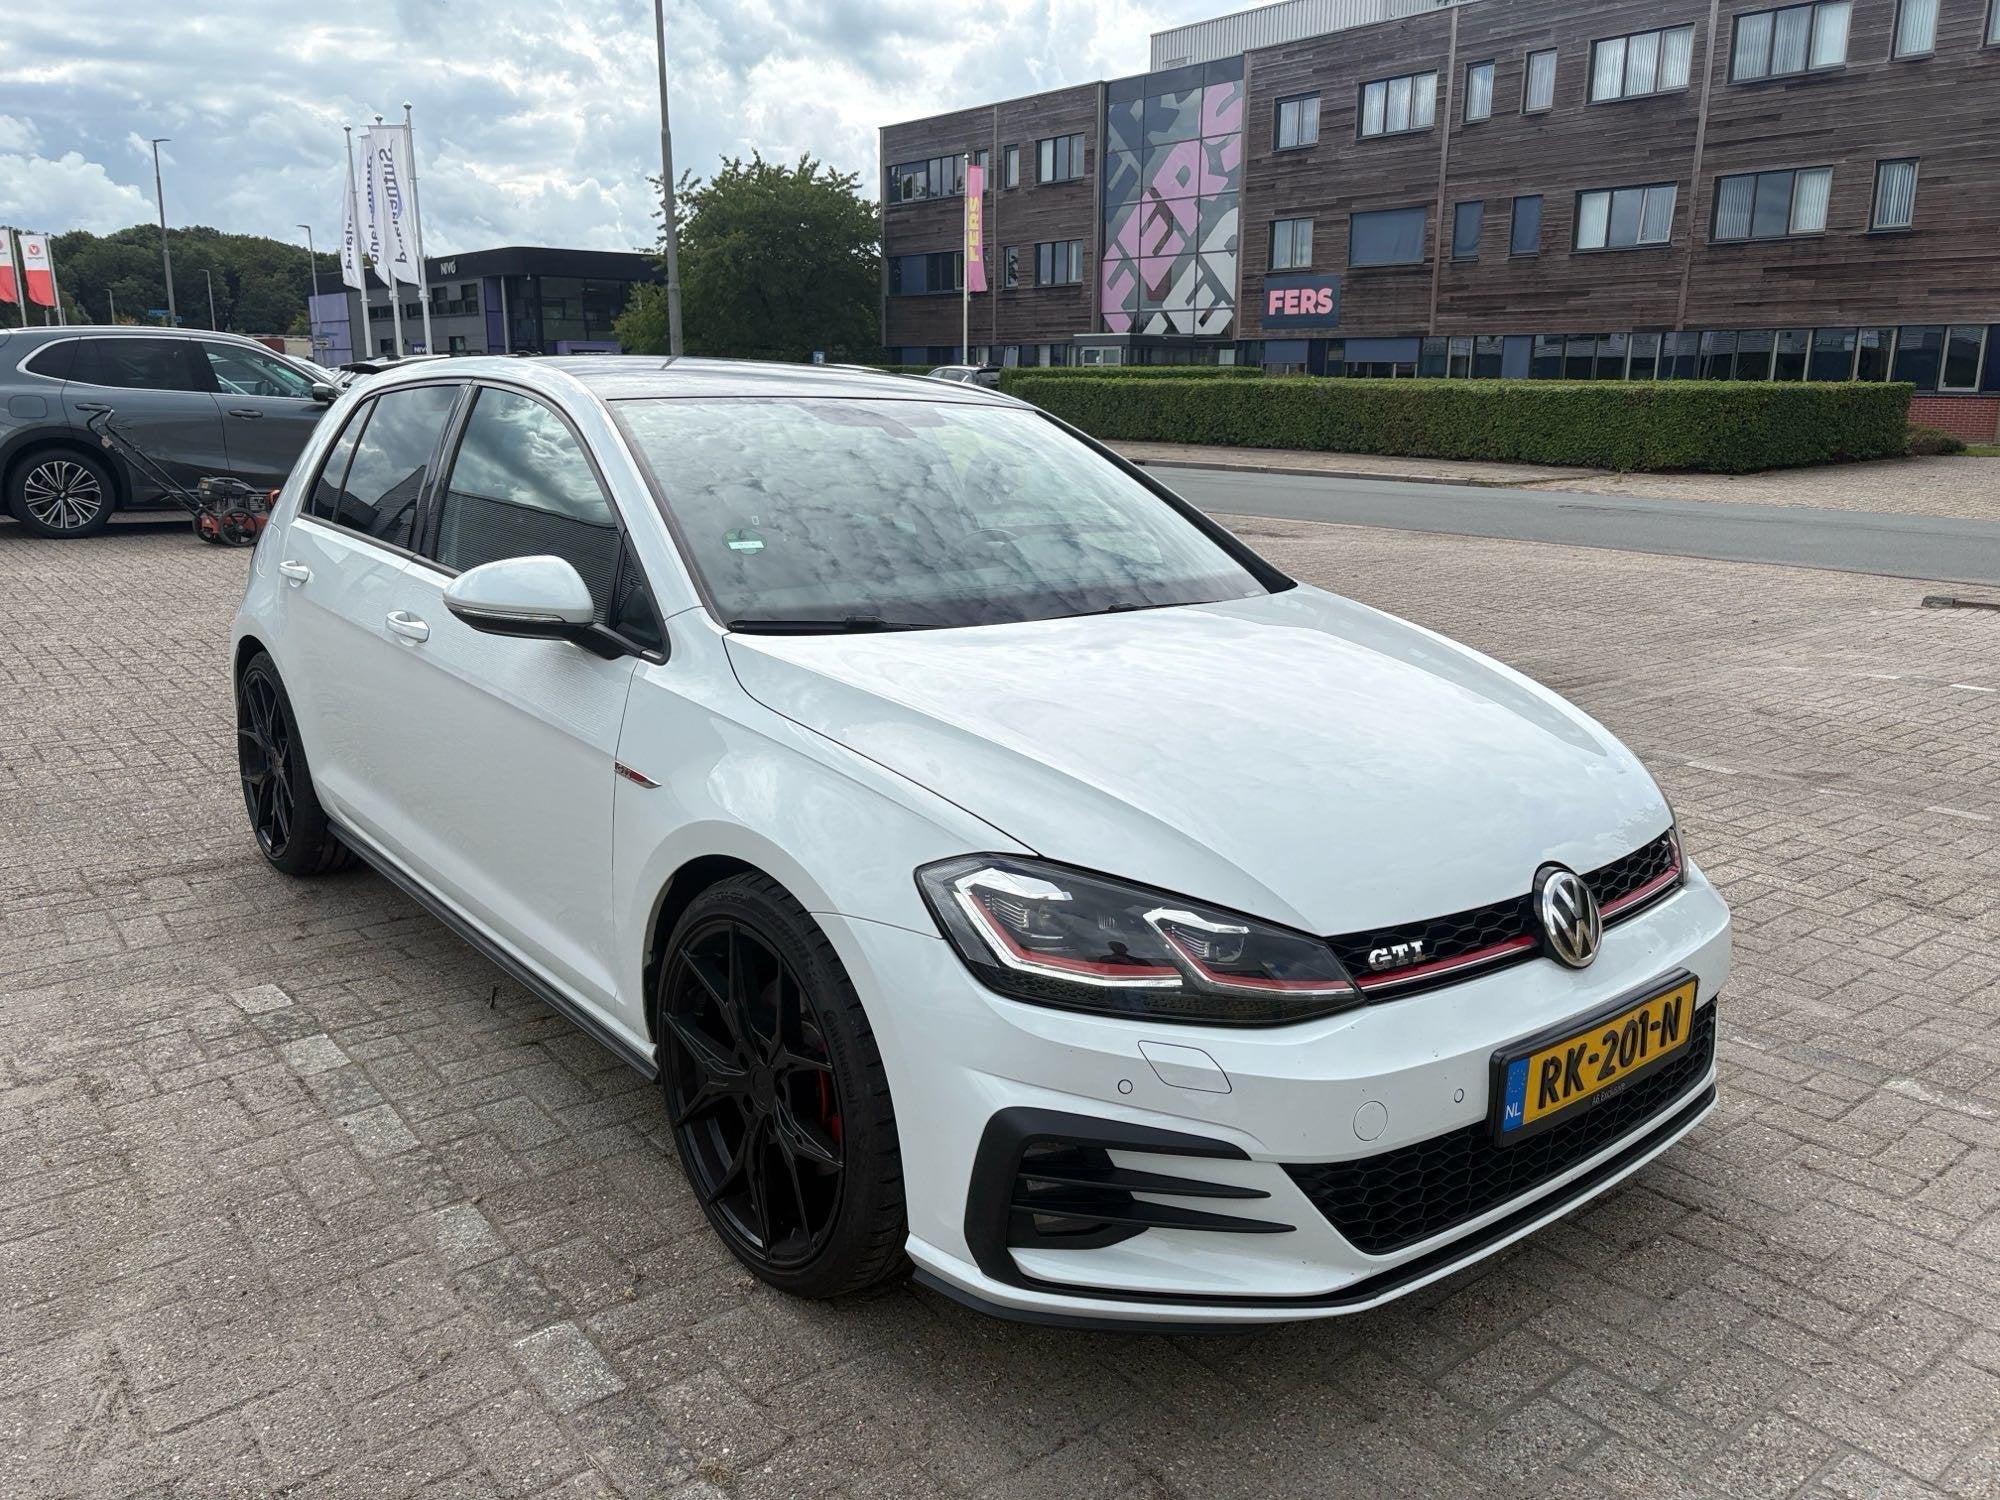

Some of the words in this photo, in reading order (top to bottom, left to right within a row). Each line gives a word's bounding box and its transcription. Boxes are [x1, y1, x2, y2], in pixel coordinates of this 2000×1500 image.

[968, 197, 979, 261] FERS
[1269, 288, 1333, 315] FERS
[1368, 940, 1426, 971] GTI
[1537, 996, 1683, 1110] RK-201-N
[1505, 1102, 1522, 1120] NL
